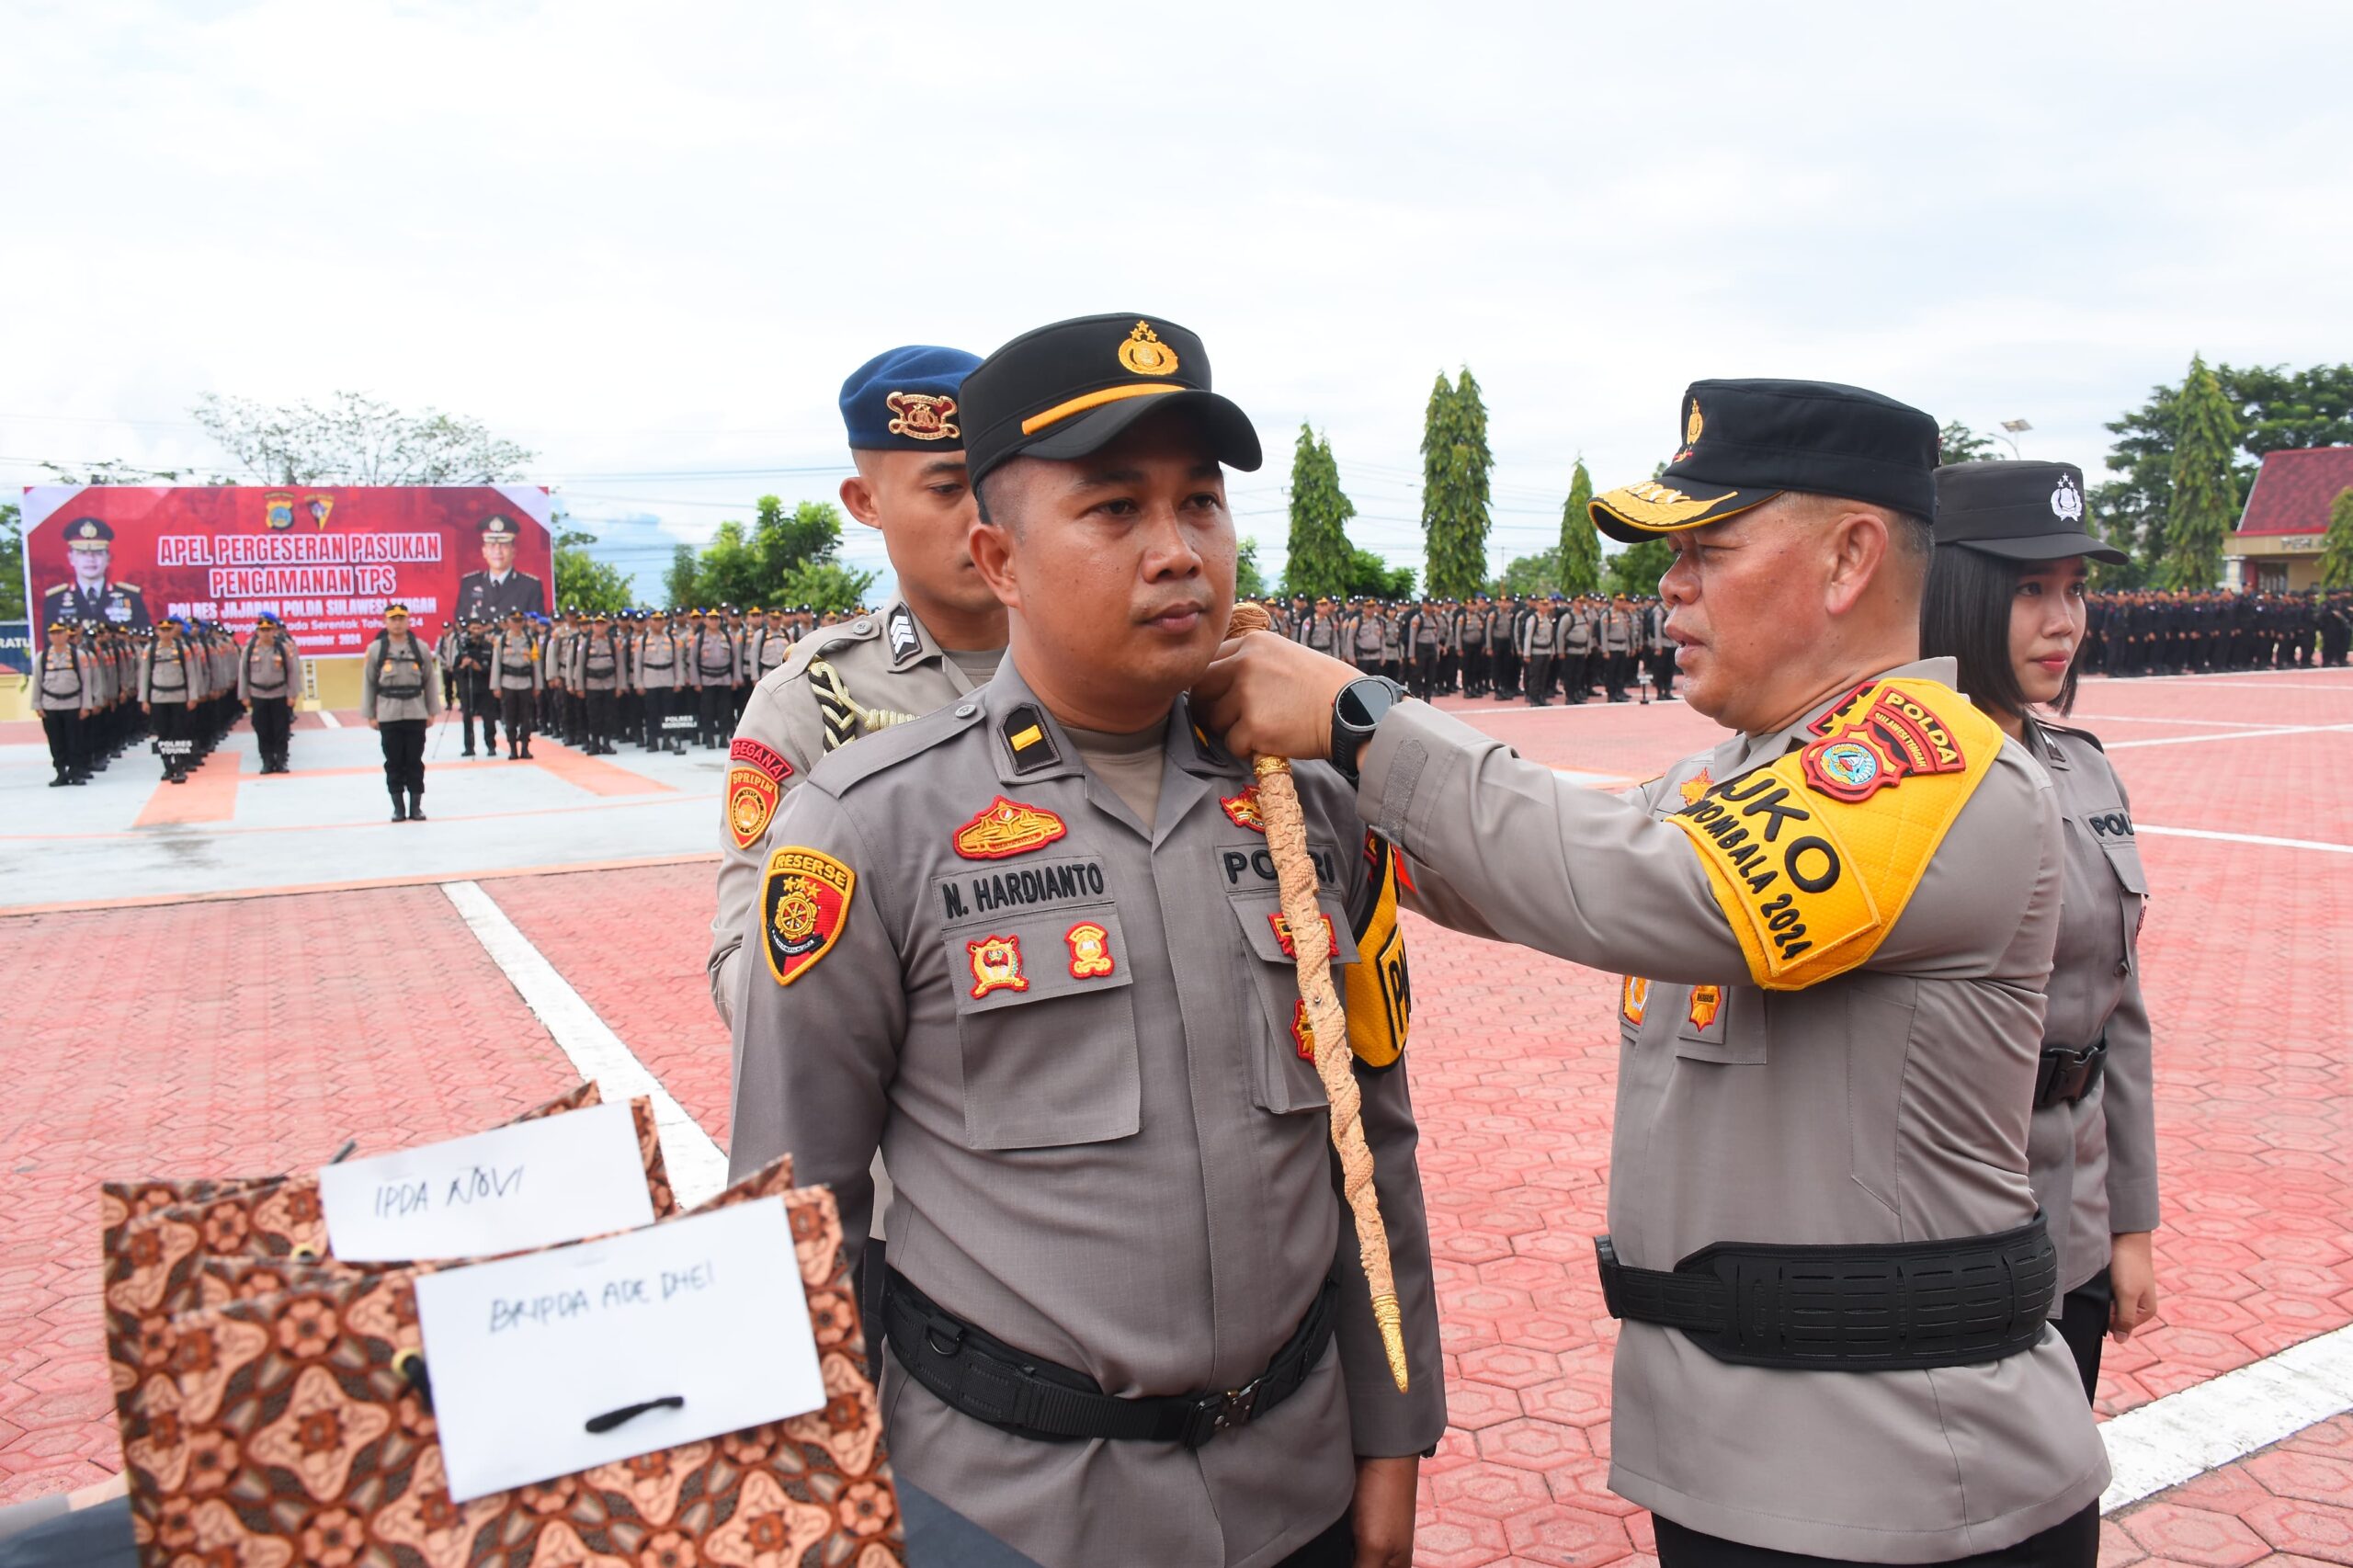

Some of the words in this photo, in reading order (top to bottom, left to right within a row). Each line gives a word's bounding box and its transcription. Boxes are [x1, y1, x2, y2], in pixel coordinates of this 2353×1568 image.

[159, 536, 212, 565] APEL
[215, 534, 346, 564] PERGESERAN
[349, 533, 441, 562] PASUKAN
[210, 566, 354, 597] PENGAMANAN
[356, 565, 396, 595] TPS
[283, 599, 324, 617] POLDA
[326, 598, 387, 616] SULAWESI
[1874, 712, 1909, 744] SULAWESI
[1905, 739, 1927, 767] TENGAH
[1884, 692, 1958, 764] POLDA
[733, 773, 774, 794] SPRIPIM
[776, 855, 847, 887] RESERSE
[1223, 849, 1336, 885] PORI
[943, 882, 969, 919] N.
[973, 862, 1104, 913] HARDIANTO
[1760, 893, 1813, 960] 2024
[375, 1181, 426, 1219] IPDA
[490, 1289, 589, 1333] BRIPDA
